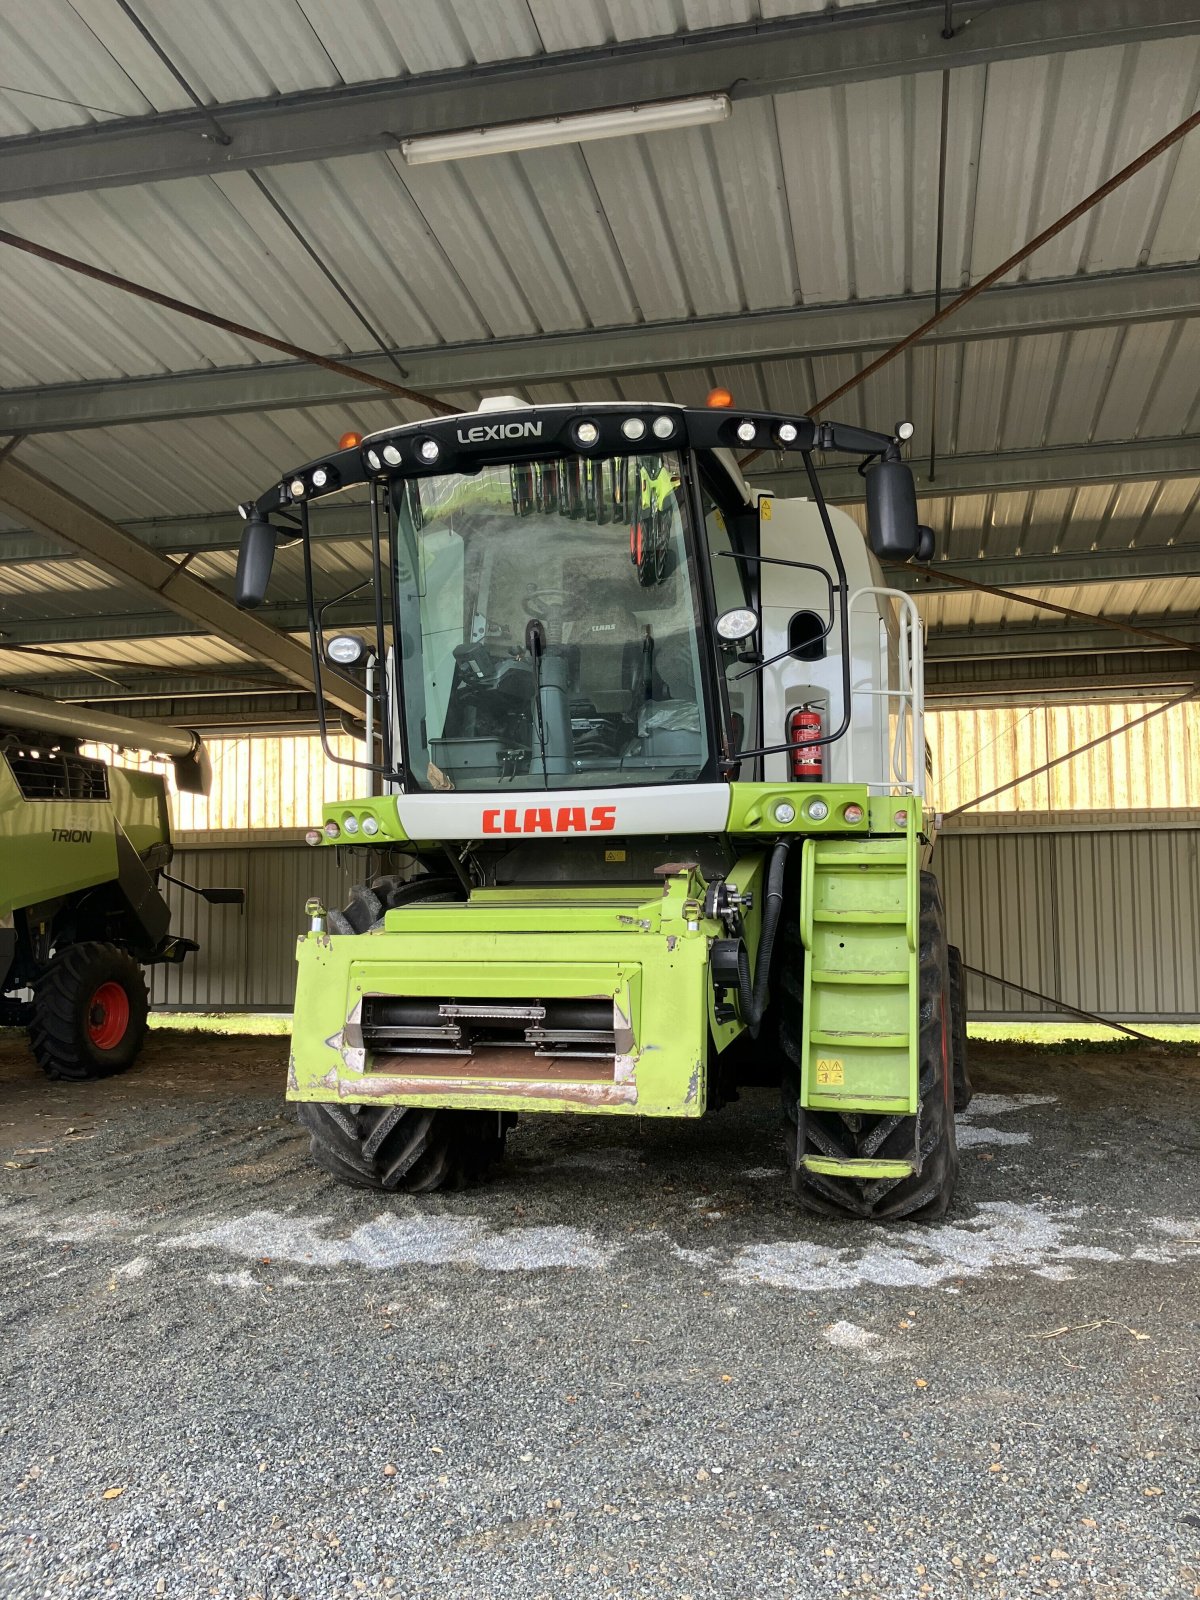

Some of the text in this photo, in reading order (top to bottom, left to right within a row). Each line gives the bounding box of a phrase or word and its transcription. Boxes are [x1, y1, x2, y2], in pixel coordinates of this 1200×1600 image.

[457, 421, 542, 444] LEXION
[482, 806, 617, 833] CLAAS
[52, 828, 92, 843] TRION
